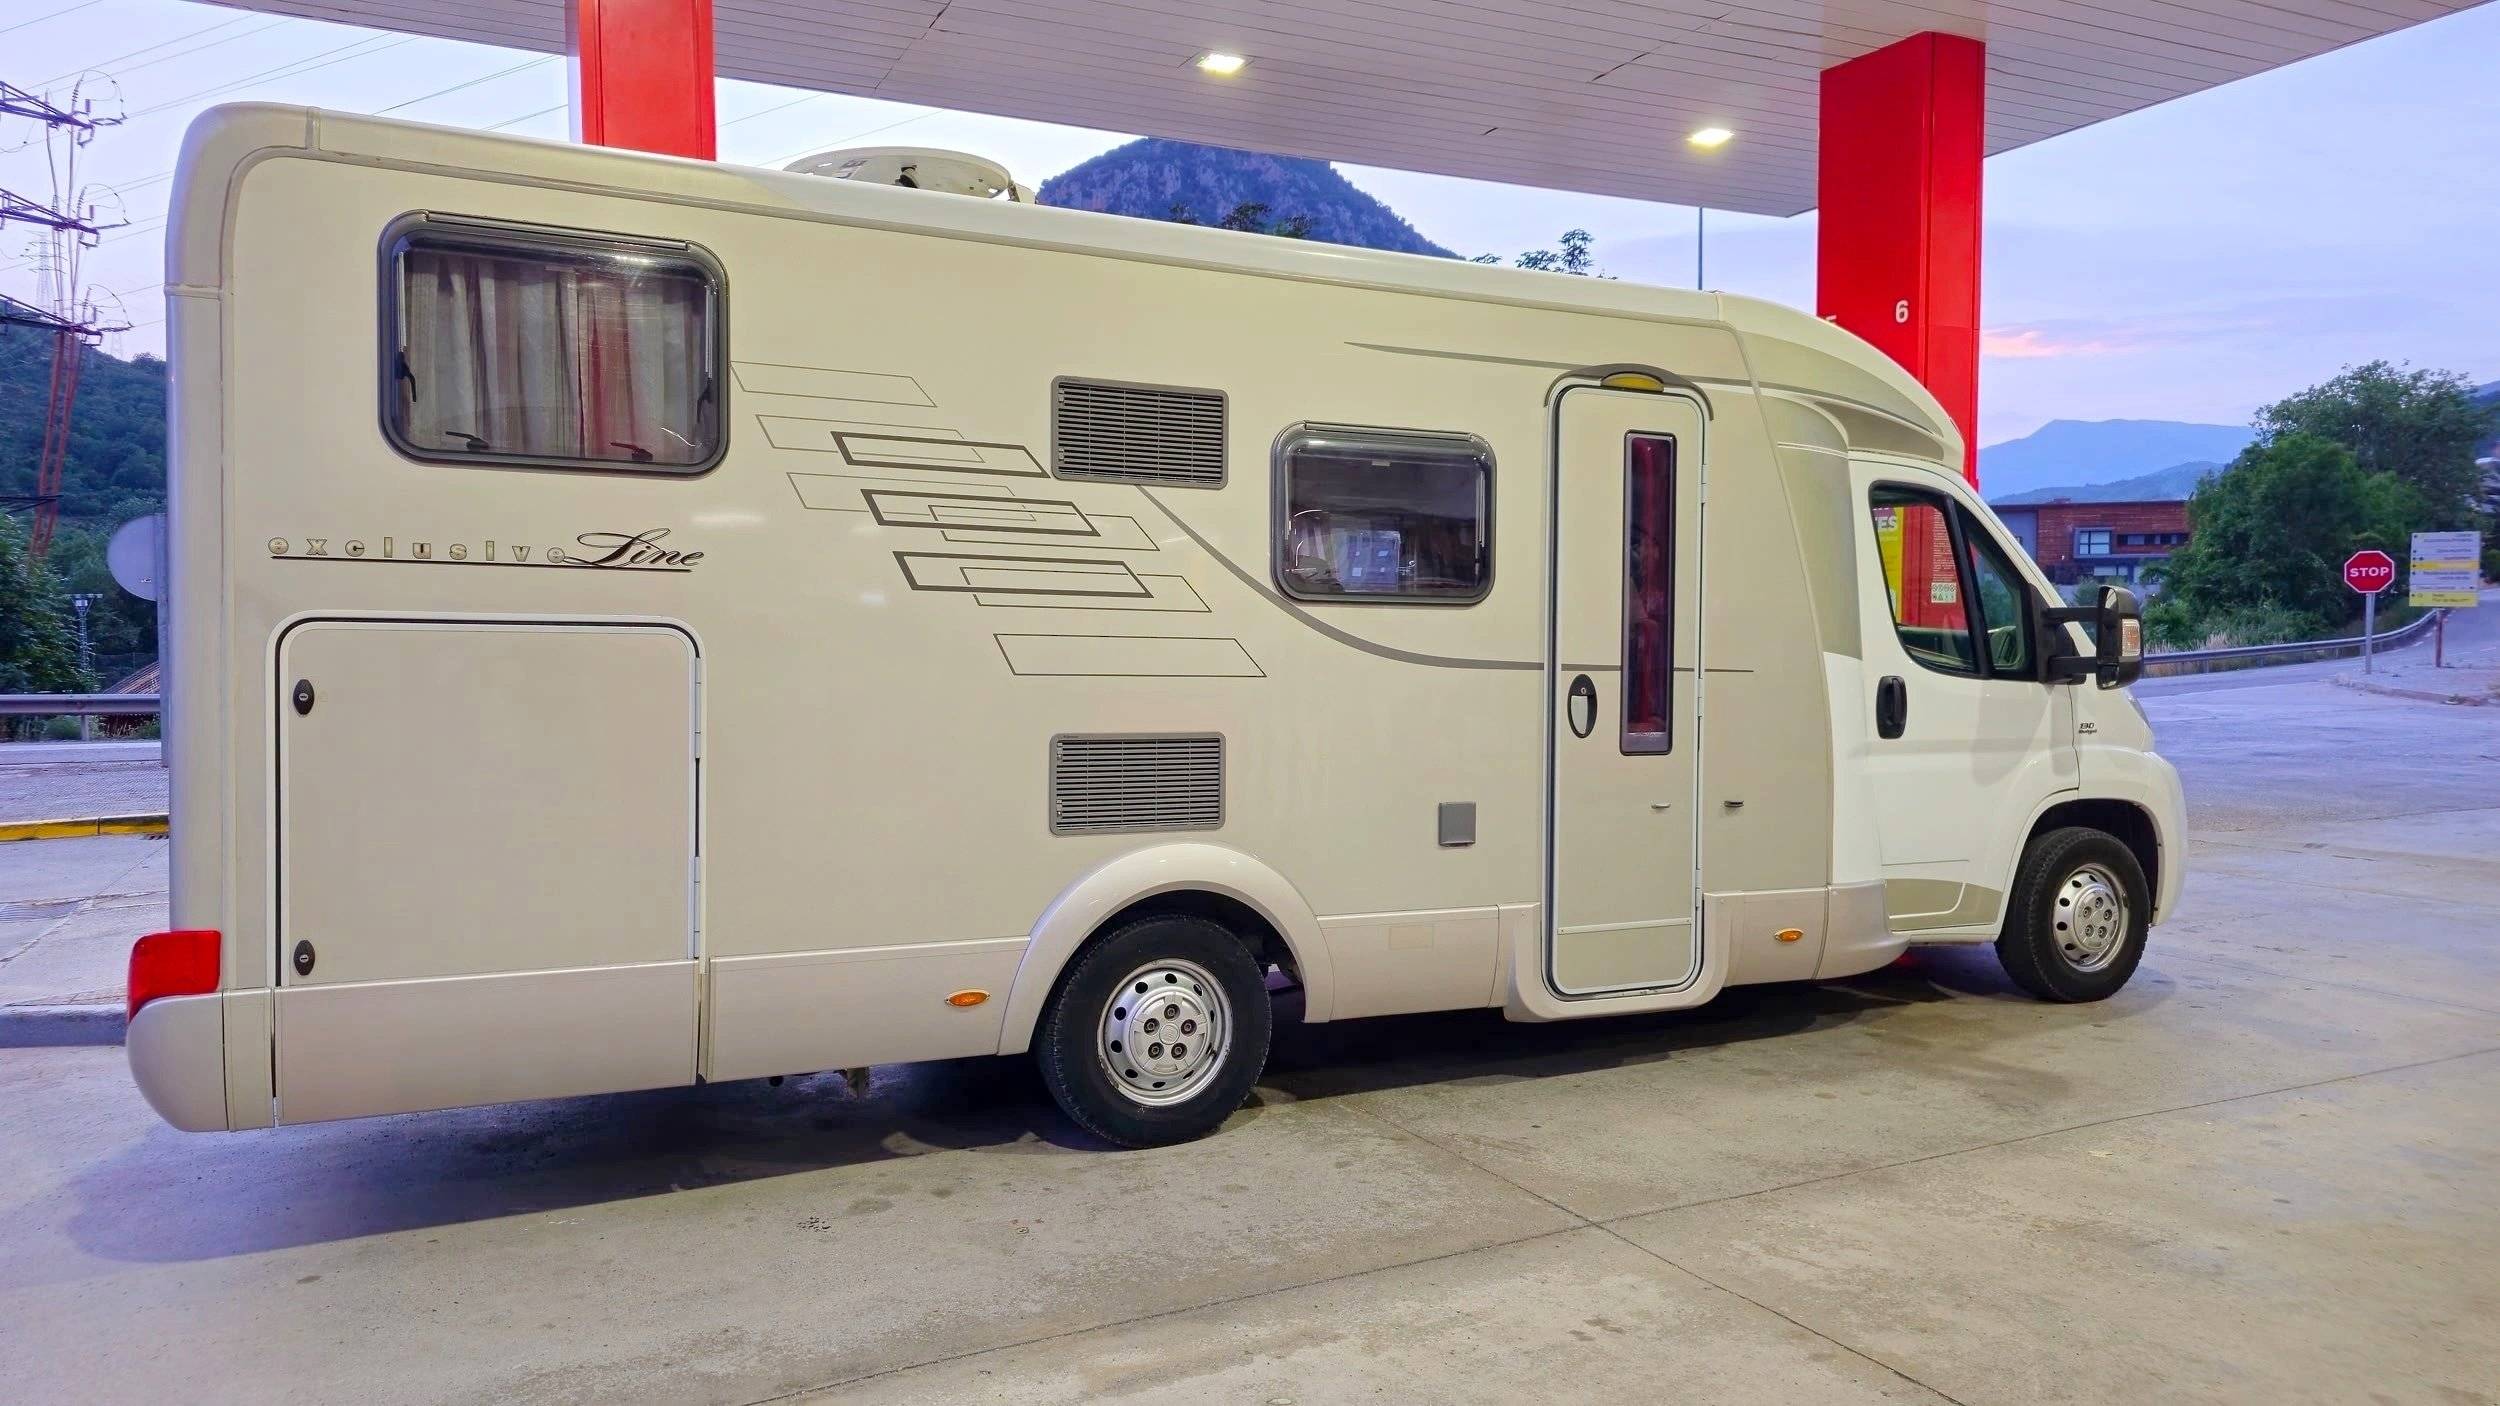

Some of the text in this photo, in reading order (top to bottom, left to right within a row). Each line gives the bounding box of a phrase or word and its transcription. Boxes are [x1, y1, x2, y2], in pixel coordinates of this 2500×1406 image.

[1895, 300, 1909, 323] 6
[268, 528, 705, 568] exclusive Line
[2350, 567, 2390, 577] STOP
